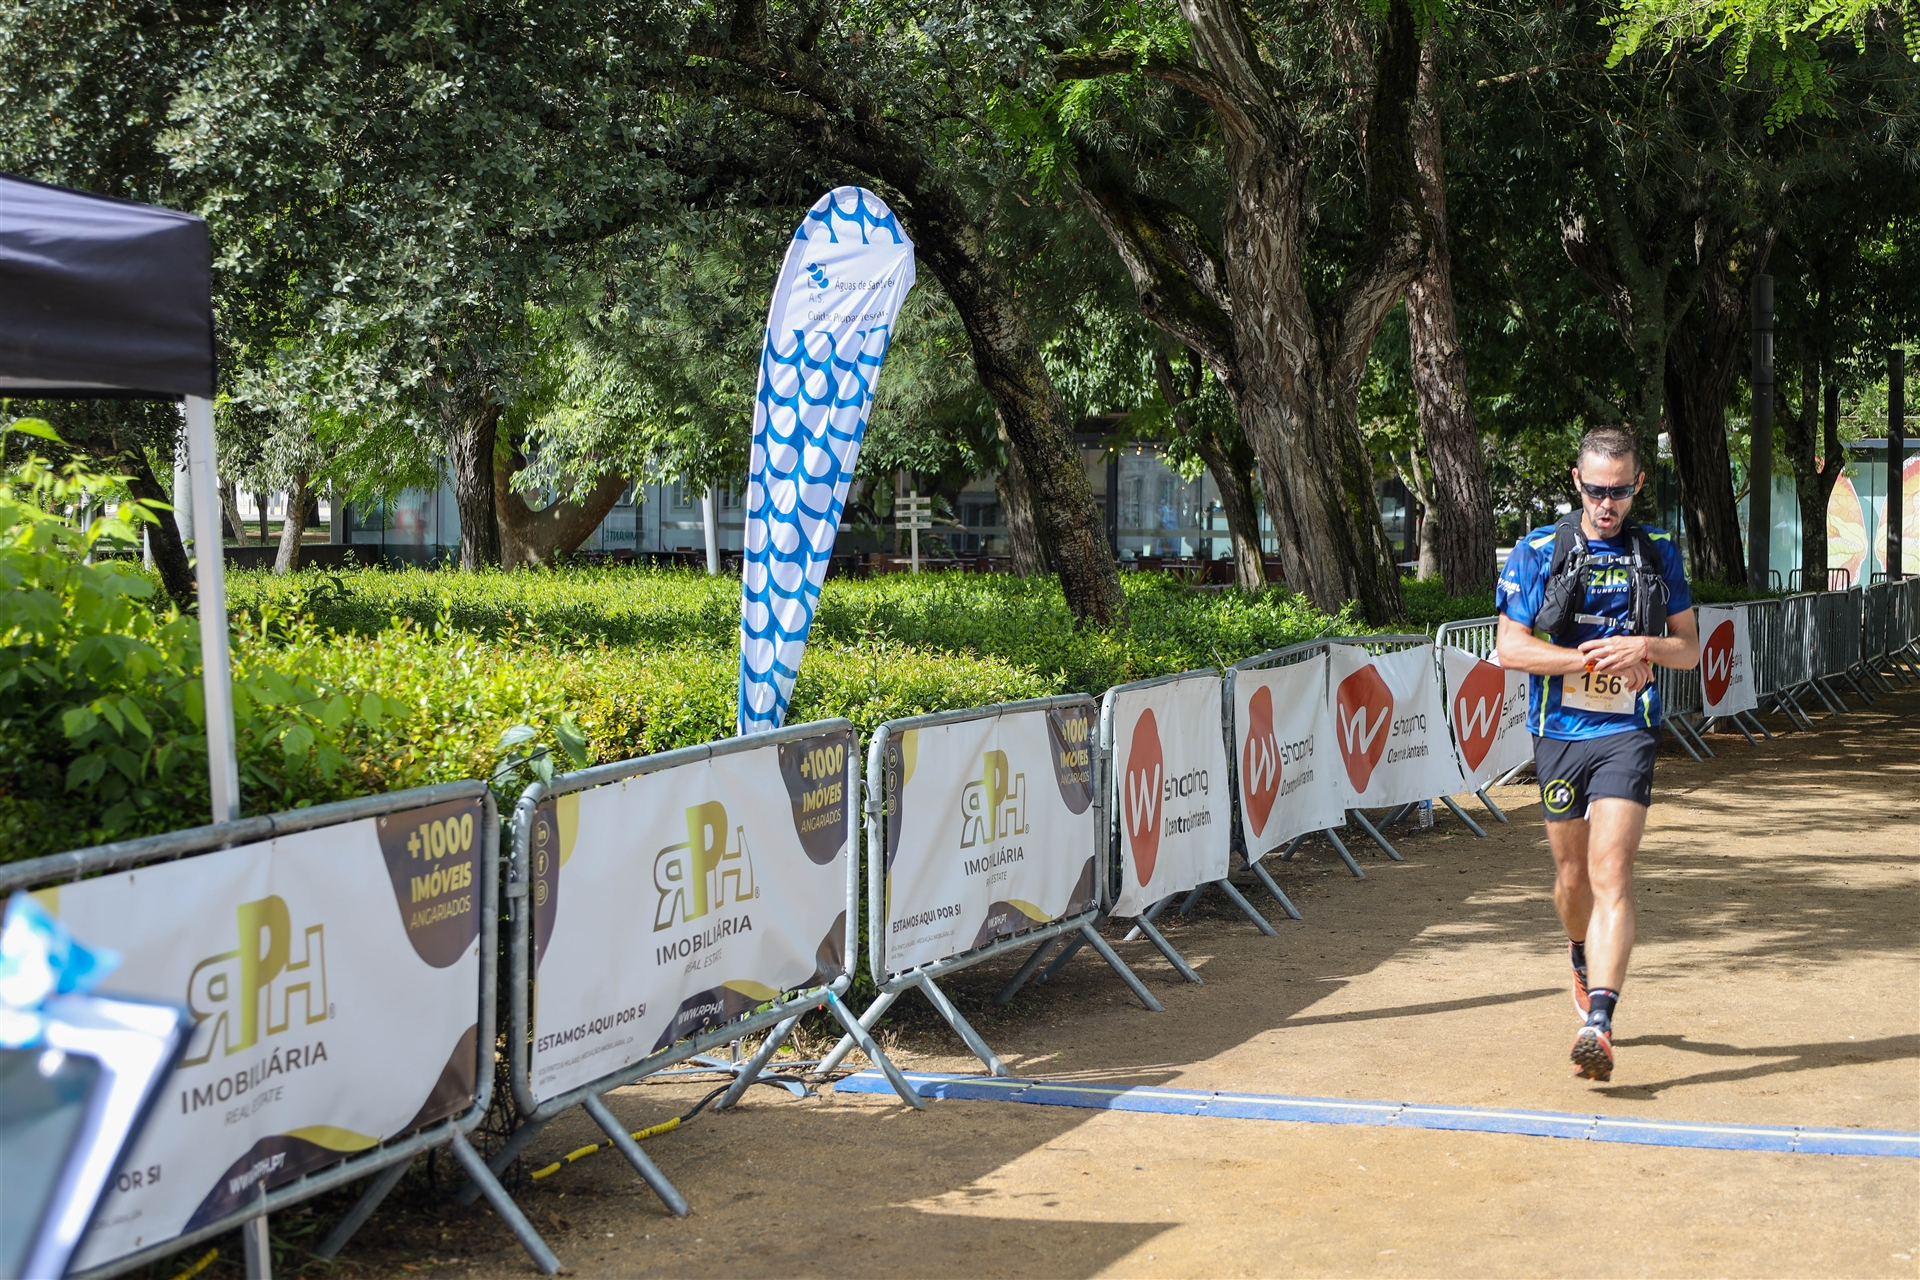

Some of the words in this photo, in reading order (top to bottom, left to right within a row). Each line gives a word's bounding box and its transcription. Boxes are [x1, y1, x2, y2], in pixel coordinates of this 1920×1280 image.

[835, 277, 856, 292] Águas
[858, 280, 867, 290] de
[1587, 565, 1628, 586] ZÍR
[1591, 586, 1628, 594] RUNNING
[1707, 646, 1733, 682] W
[1580, 672, 1622, 695] 156
[1339, 706, 1389, 755] W
[1459, 692, 1502, 742] W
[800, 743, 844, 780] +1000
[1250, 732, 1276, 796] W
[802, 781, 842, 813] IMÓVEIS
[1129, 763, 1161, 837] W
[407, 813, 473, 861] +1000
[800, 808, 842, 834] ANGARIADOS
[411, 861, 473, 904] IMÓVEIS
[409, 895, 472, 931] ANGARIADOS
[892, 914, 919, 934] ESTAMOS
[919, 909, 936, 926] AQUI
[937, 904, 954, 920] POR
[954, 903, 962, 916] SI
[656, 914, 753, 966] IMOBILIÁRIA
[703, 948, 723, 969] ESTATE
[537, 1023, 586, 1053] ESTAMOS
[587, 1014, 614, 1035] AQUI
[616, 1006, 636, 1028] POR
[637, 1002, 647, 1019] SI
[181, 1041, 328, 1115] IMOBILIÁRIA
[113, 1170, 143, 1194] OR
[147, 1163, 162, 1186] SI
